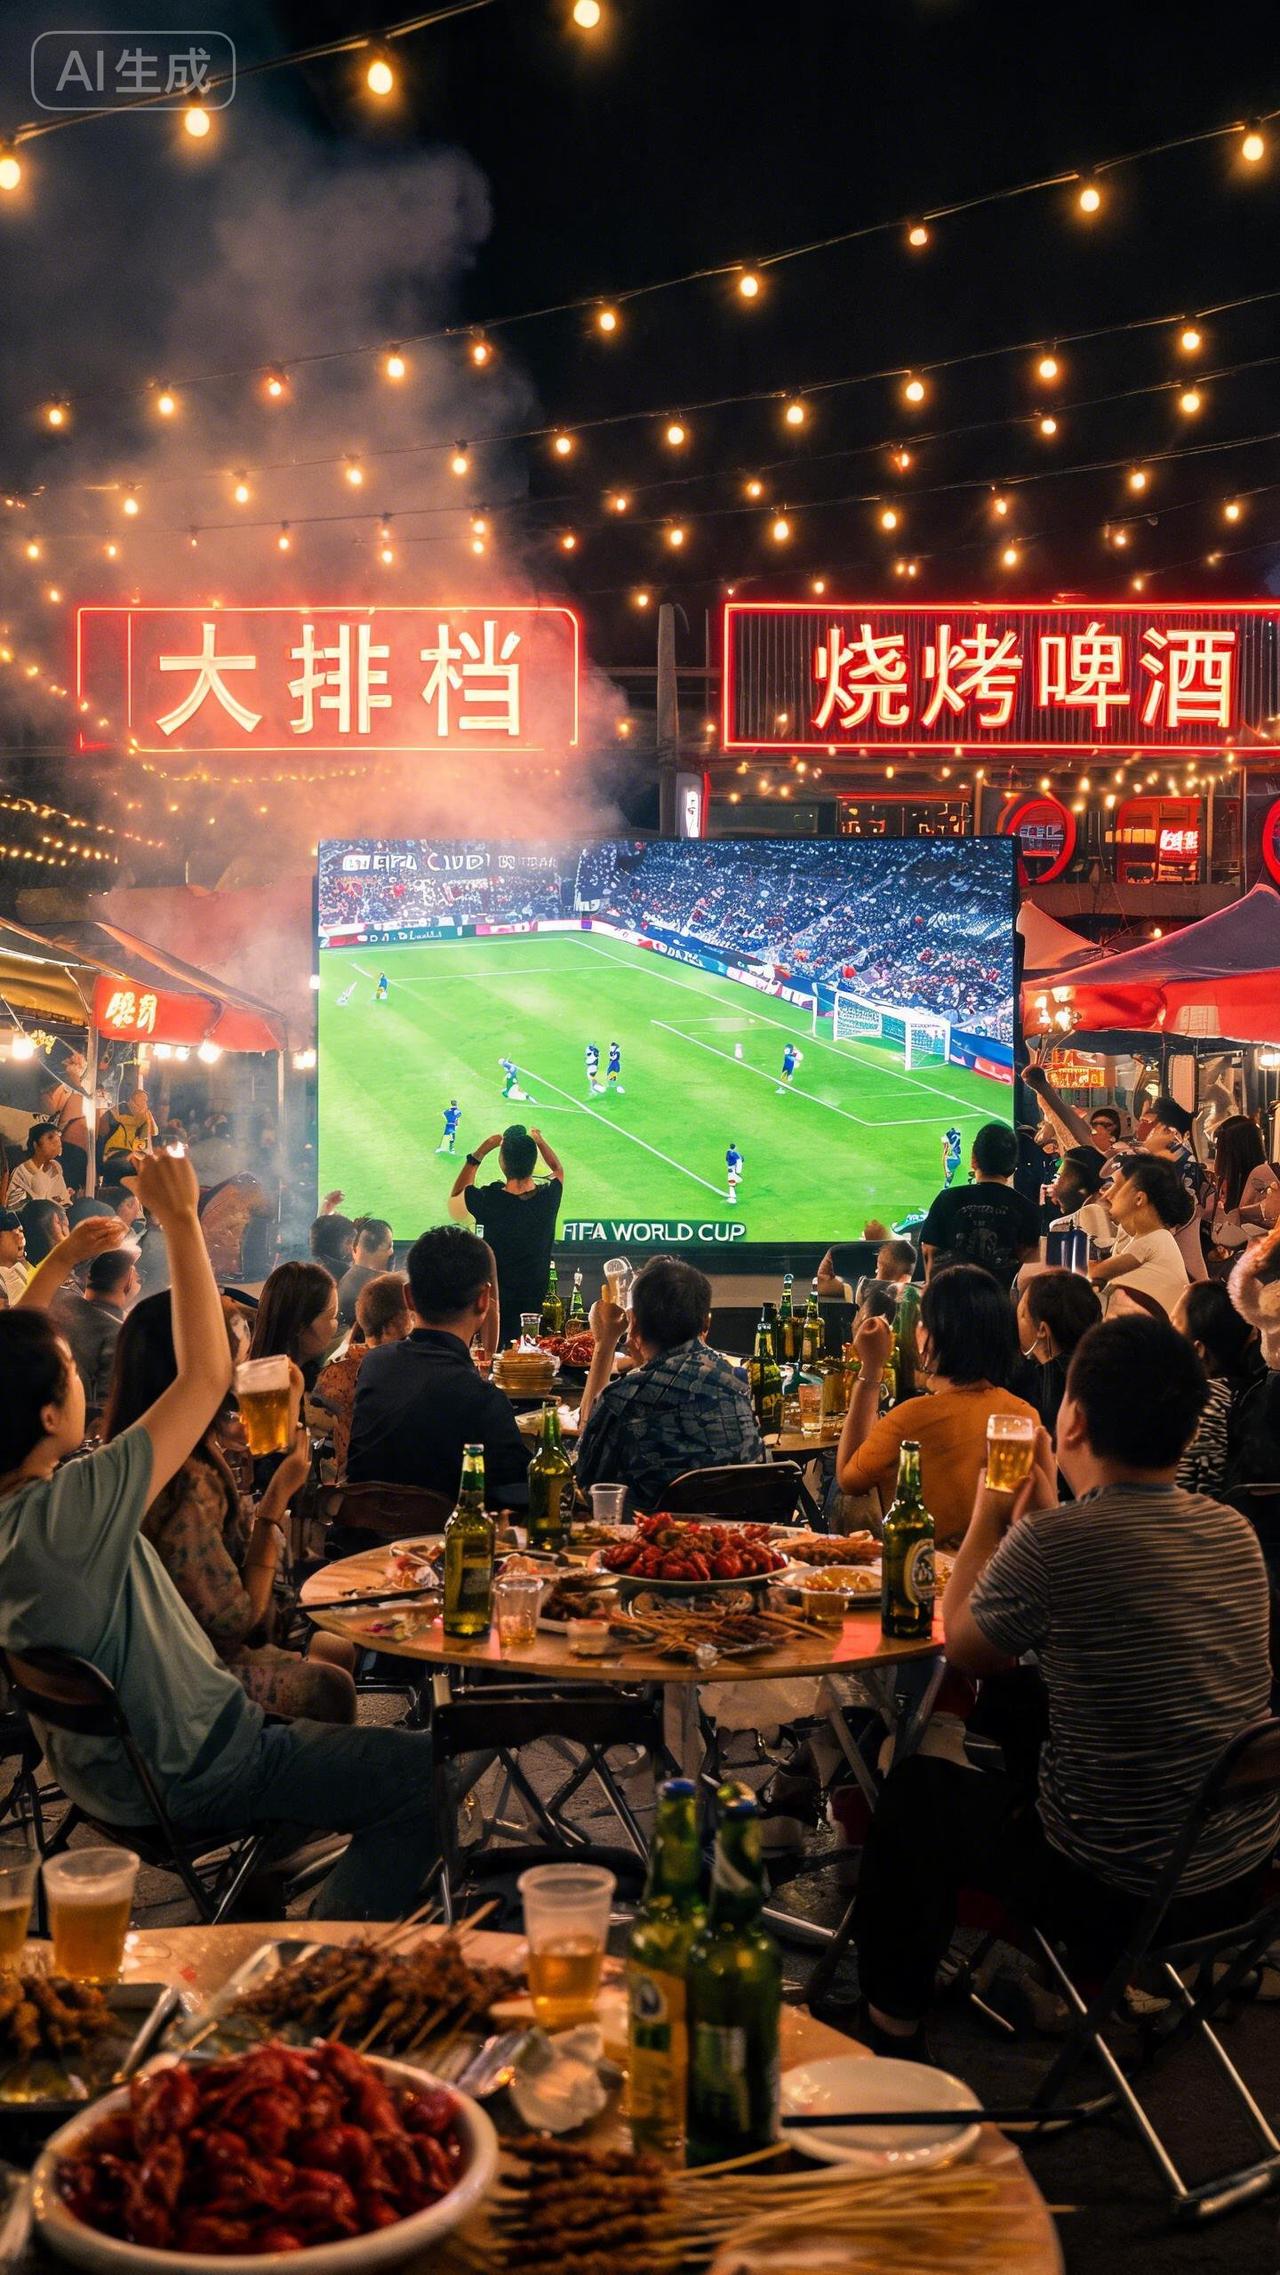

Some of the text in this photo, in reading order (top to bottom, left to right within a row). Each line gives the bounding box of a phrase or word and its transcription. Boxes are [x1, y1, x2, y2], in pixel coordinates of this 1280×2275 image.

[156, 620, 521, 736] 大排档
[811, 621, 1236, 728] 烧烤啤酒
[563, 1222, 746, 1242] FIFA WORLD CUP
